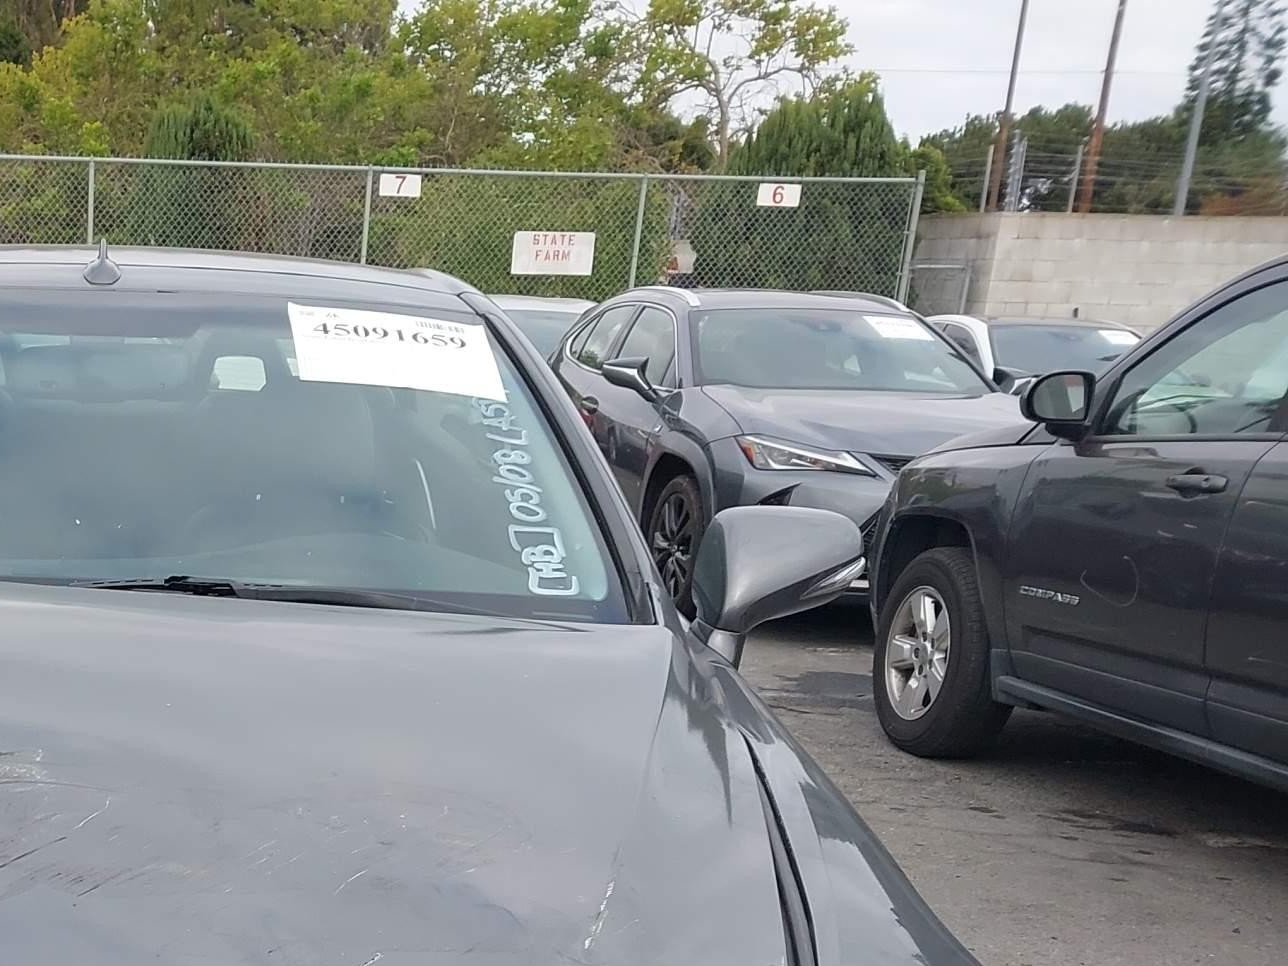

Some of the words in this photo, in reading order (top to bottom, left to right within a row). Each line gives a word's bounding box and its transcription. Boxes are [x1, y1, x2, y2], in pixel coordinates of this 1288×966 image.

[394, 175, 407, 194] 7
[772, 185, 785, 204] 6
[532, 233, 577, 246] STATE
[535, 249, 571, 261] FARM
[312, 322, 467, 349] 45091659
[1019, 585, 1081, 606] COMPASS
